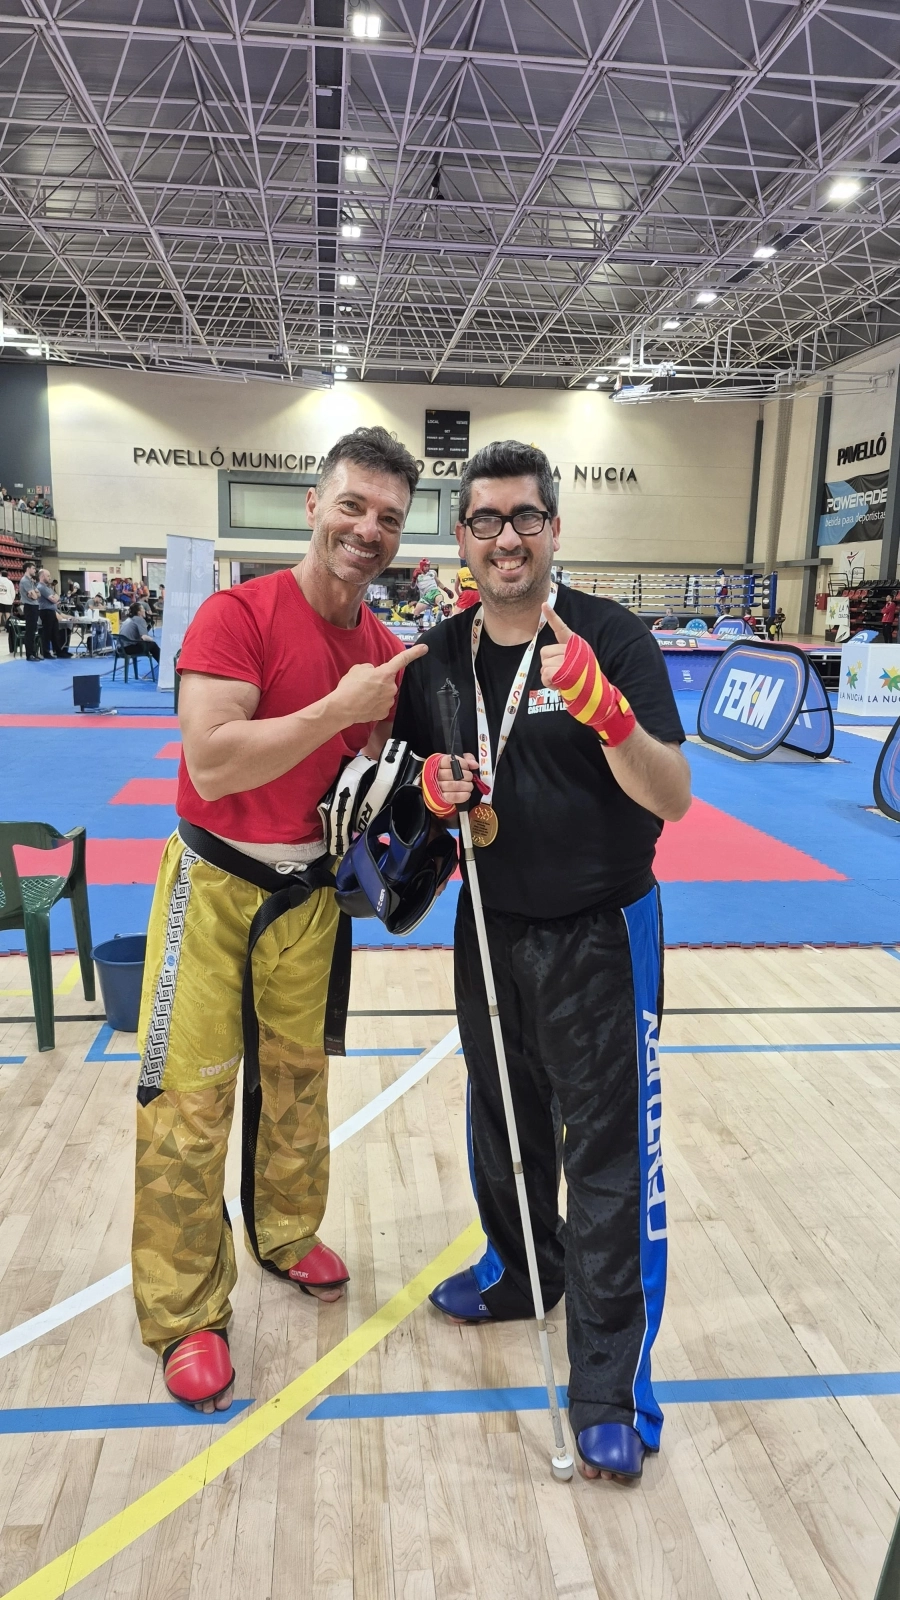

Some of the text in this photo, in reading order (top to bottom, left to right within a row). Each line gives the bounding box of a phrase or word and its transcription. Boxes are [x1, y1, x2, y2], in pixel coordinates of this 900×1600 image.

[837, 432, 887, 466] PAVELLÓ
[133, 446, 225, 467] PAVELLÓ
[232, 451, 326, 473] MUNICIPA
[432, 460, 467, 477] CA
[826, 487, 888, 512] POWERADE
[825, 516, 841, 527] bebida
[842, 515, 854, 527] para
[713, 668, 785, 730] FEKM
[867, 695, 900, 703] LA NU
[528, 704, 555, 715] CASTILLA
[555, 703, 560, 711] Y
[199, 1064, 222, 1078] TOP
